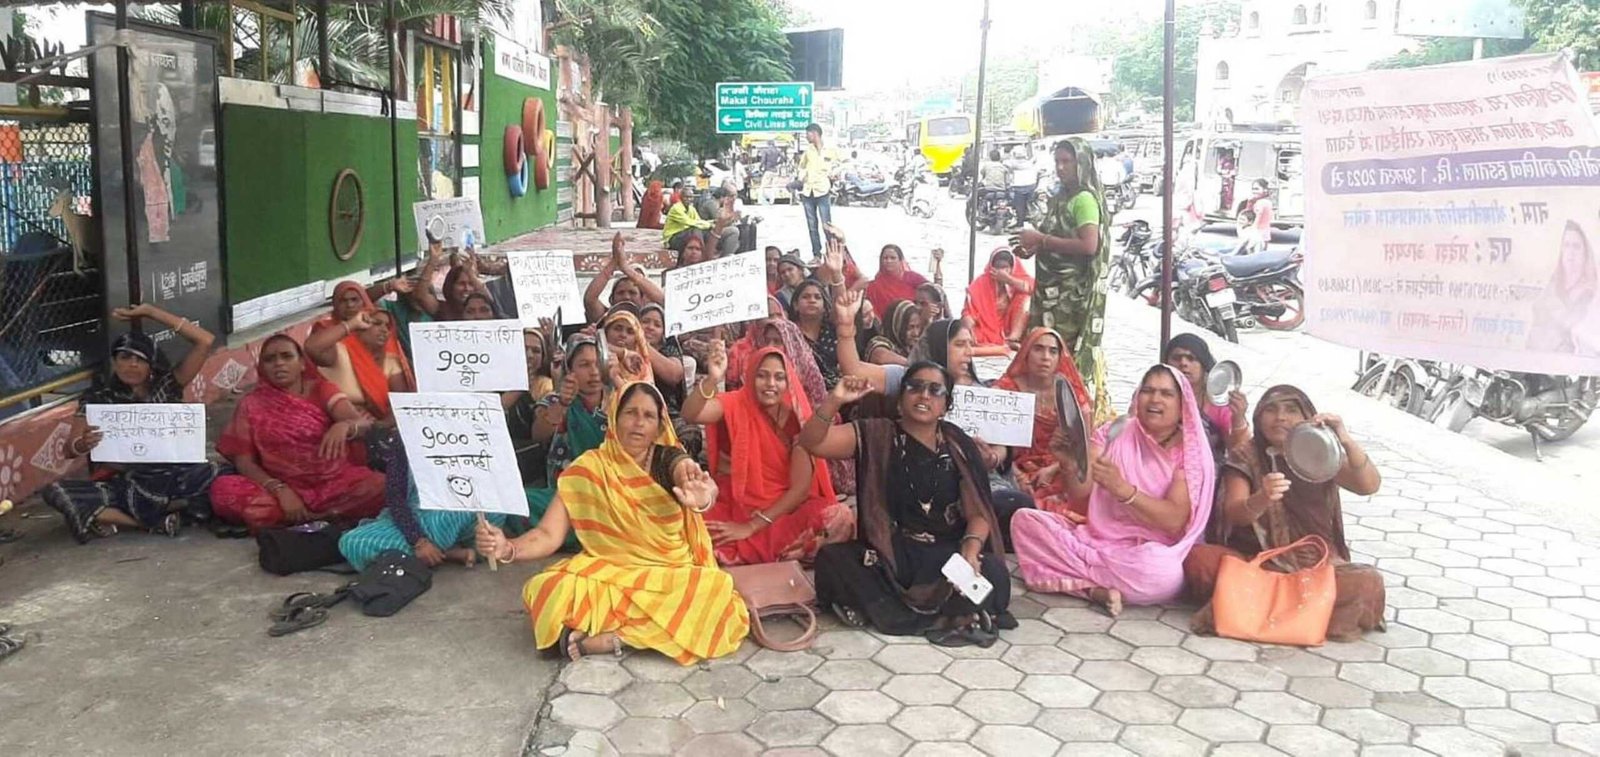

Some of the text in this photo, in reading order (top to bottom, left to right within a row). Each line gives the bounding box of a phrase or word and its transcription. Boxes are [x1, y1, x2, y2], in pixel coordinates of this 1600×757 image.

[682, 289, 734, 312] 9000
[436, 350, 490, 371] 9000
[420, 426, 469, 449] 9000
